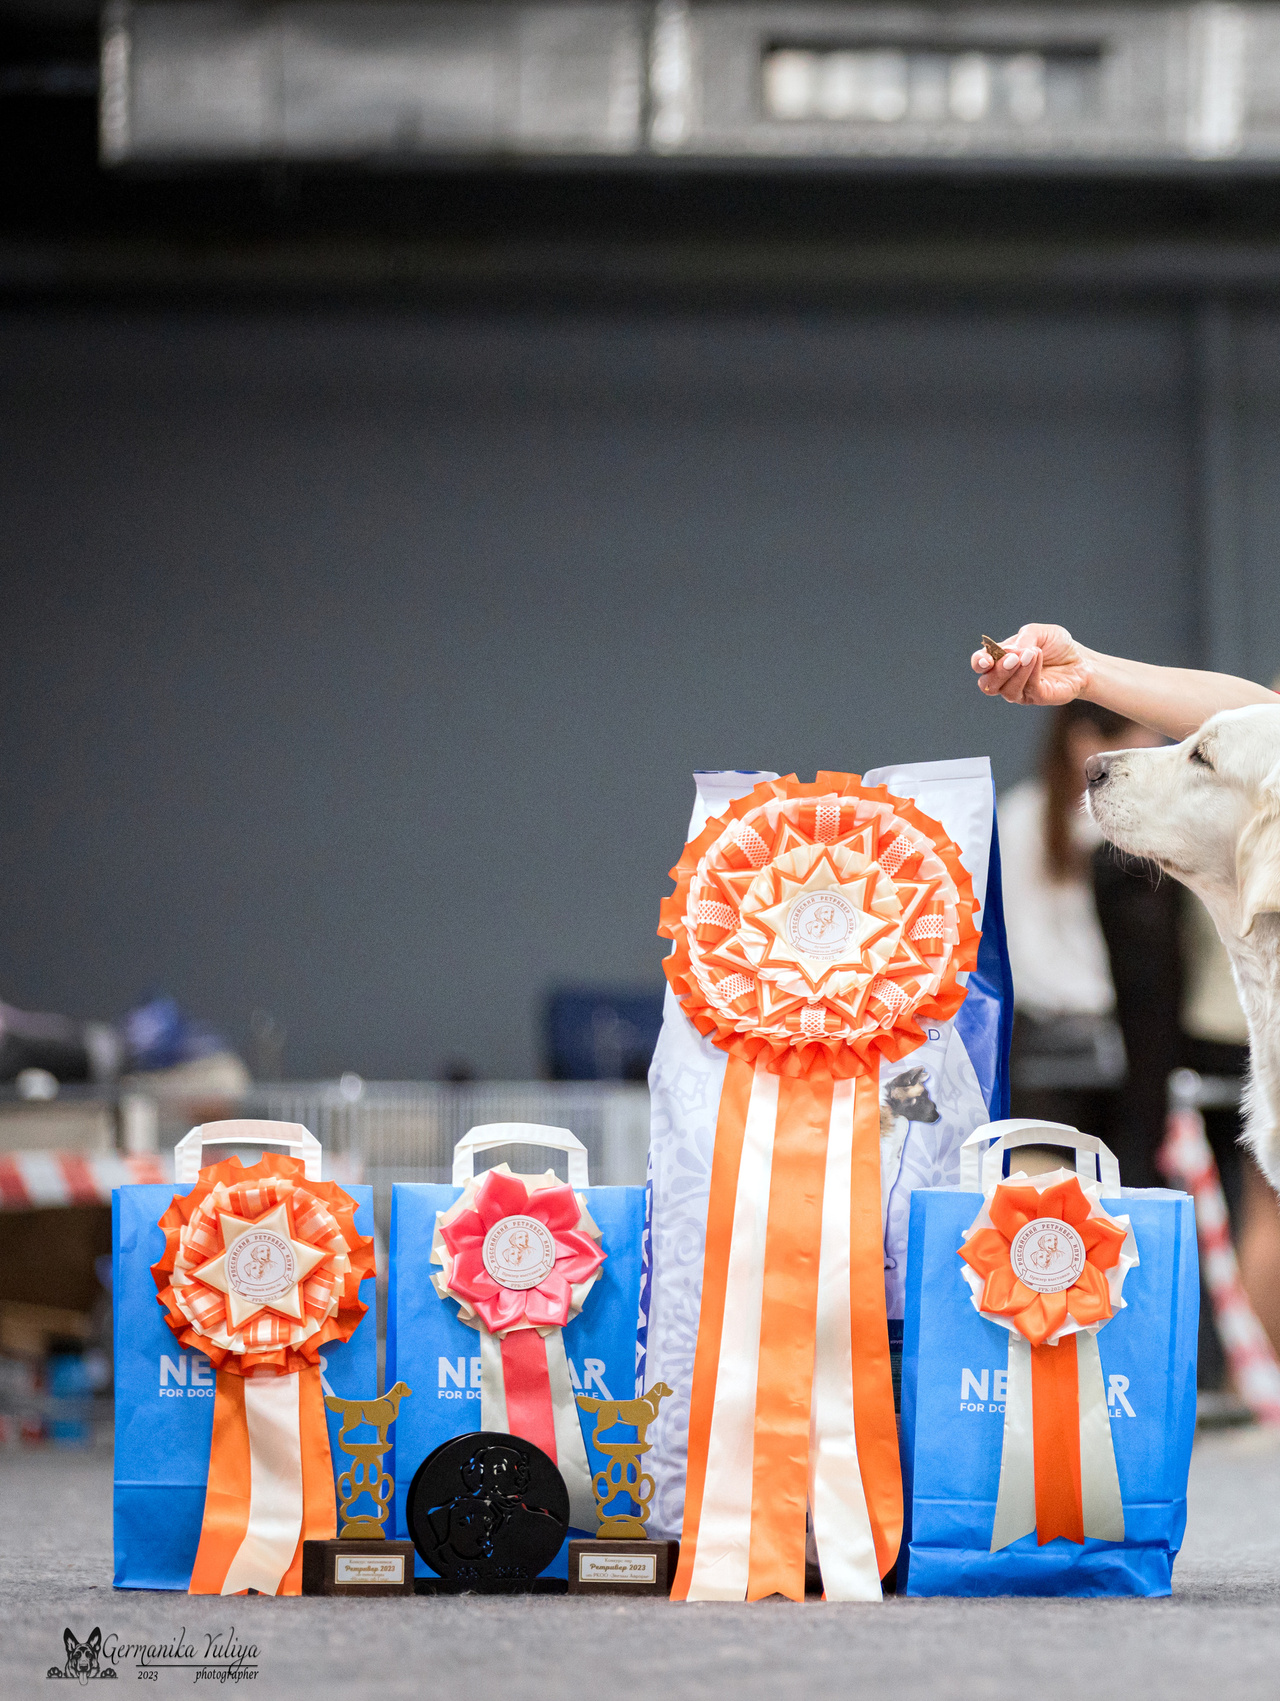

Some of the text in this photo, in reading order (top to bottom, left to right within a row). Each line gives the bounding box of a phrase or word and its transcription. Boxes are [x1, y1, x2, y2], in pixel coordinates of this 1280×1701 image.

[512, 1221, 544, 1236] РЕТРИВЕР
[254, 1235, 286, 1250] РЕТРИВЕР
[1017, 1227, 1037, 1266] РОССИЙСКИЙ
[1042, 1224, 1074, 1240] РЕТРИВЕР
[159, 1388, 216, 1398] FOR DOG
[438, 1391, 463, 1400] FOR
[960, 1402, 985, 1412] FOR
[589, 1563, 628, 1573] Ретривер
